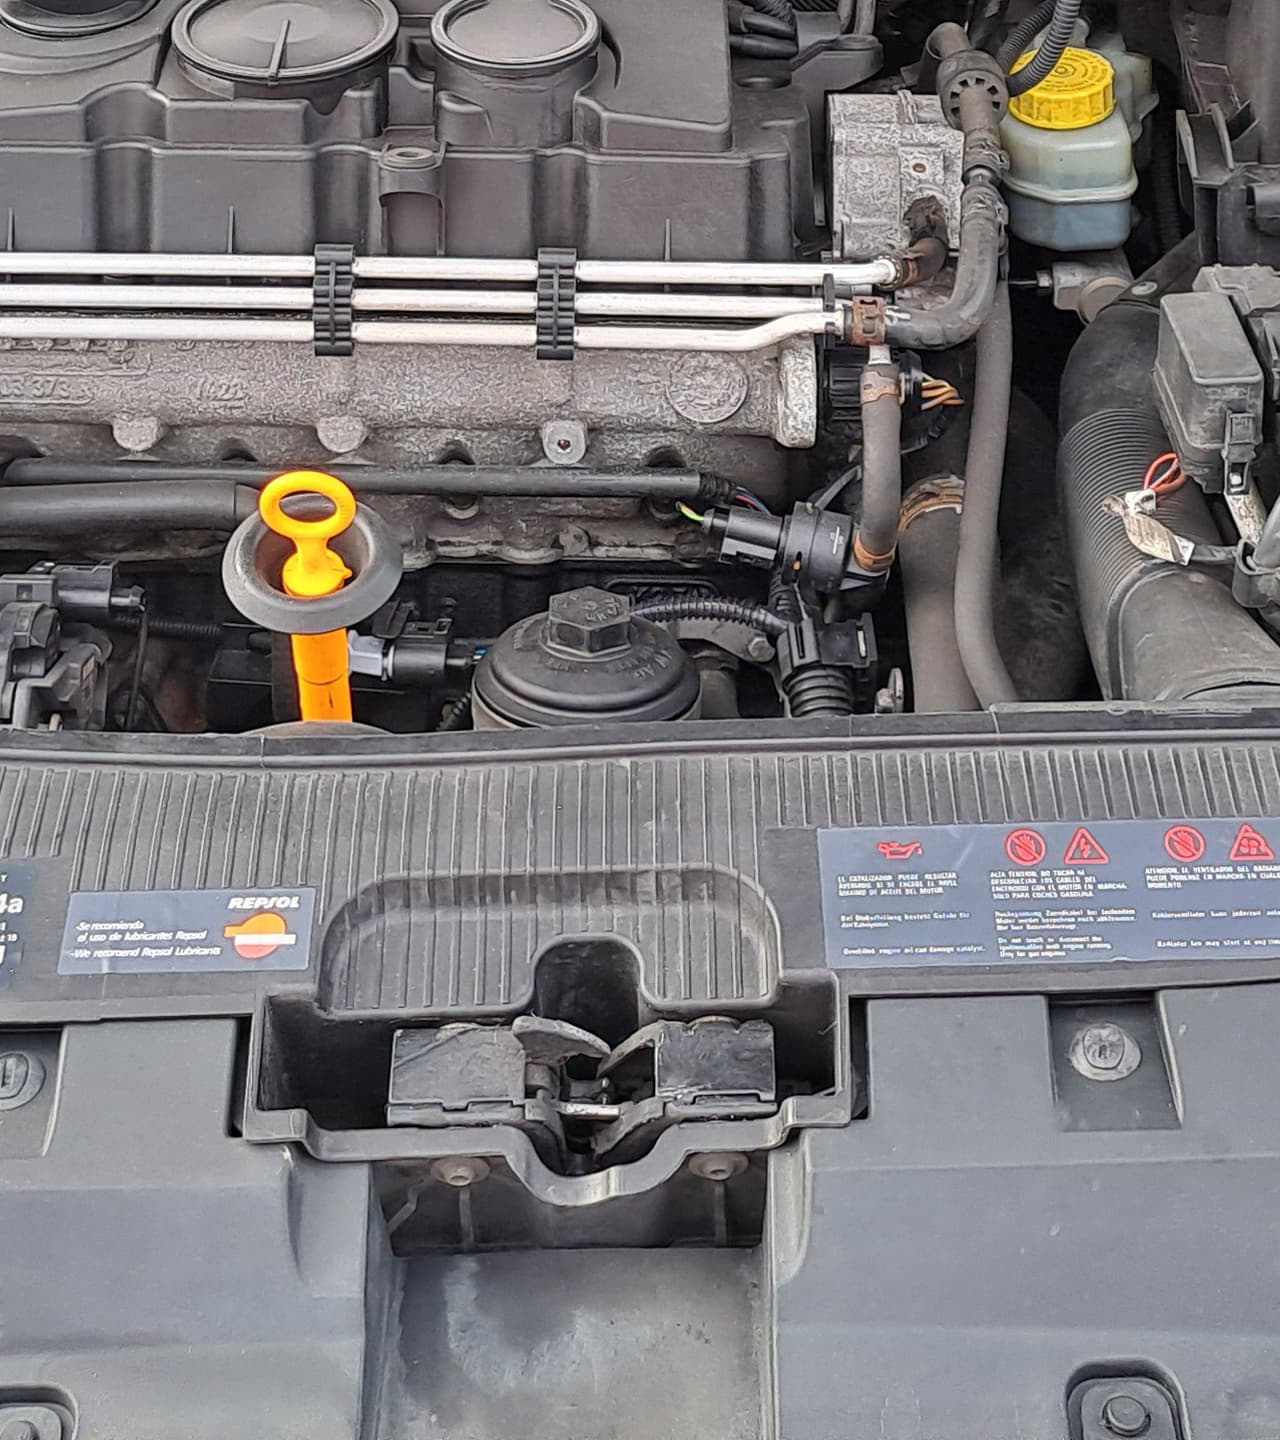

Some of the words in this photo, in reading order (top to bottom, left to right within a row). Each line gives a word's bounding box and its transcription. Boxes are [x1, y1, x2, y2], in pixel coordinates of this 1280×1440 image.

[227, 896, 300, 909] REPSOL
[109, 931, 122, 941] de
[124, 930, 173, 942] lubricantes
[175, 929, 208, 941] Repsol
[142, 946, 174, 959] Repsol
